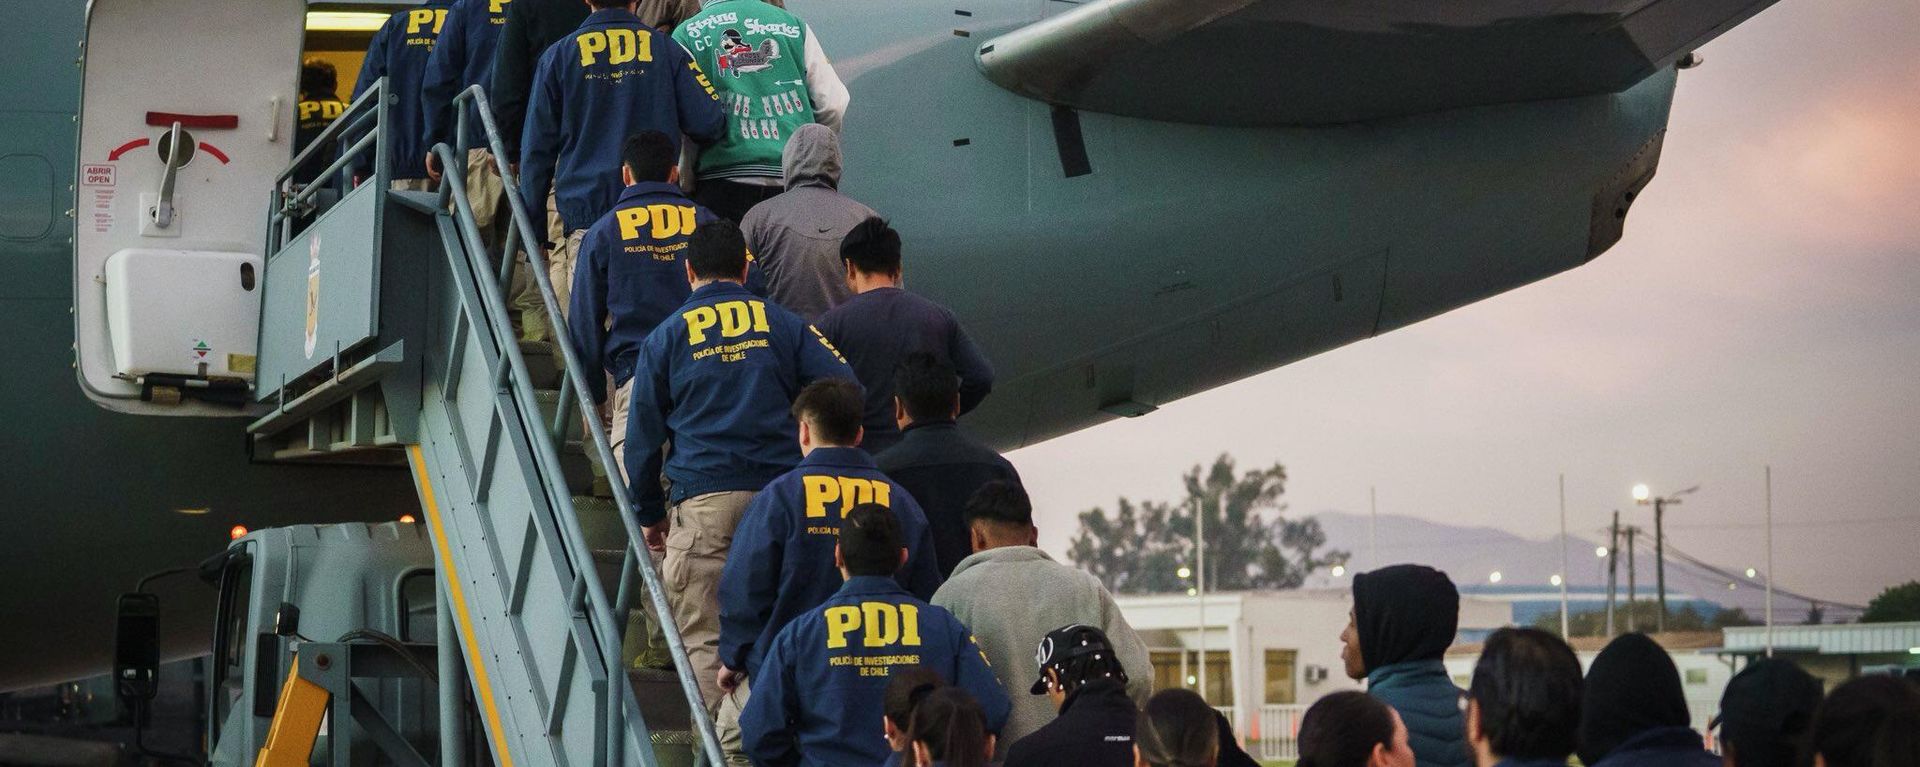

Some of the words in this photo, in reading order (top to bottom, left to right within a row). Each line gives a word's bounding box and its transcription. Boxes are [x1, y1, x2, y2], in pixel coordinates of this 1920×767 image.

[576, 29, 653, 67] PDI
[299, 101, 350, 120] PD
[87, 167, 112, 175] ABRIR
[88, 175, 110, 184] OPEN
[616, 204, 697, 241] PDI
[647, 244, 654, 252] DE
[660, 253, 675, 262] CHILE
[682, 300, 770, 346] PDI
[692, 346, 715, 361] POLICÍA
[715, 345, 724, 354] DE
[724, 338, 769, 353] INVESTIGACIONE
[721, 354, 729, 363] DE
[729, 351, 747, 363] CHILE
[824, 601, 922, 648] PDI
[854, 656, 864, 666] DE
[864, 655, 920, 666] INVESTIGACIONES
[860, 666, 869, 676] DE
[870, 666, 889, 676] CHILE
